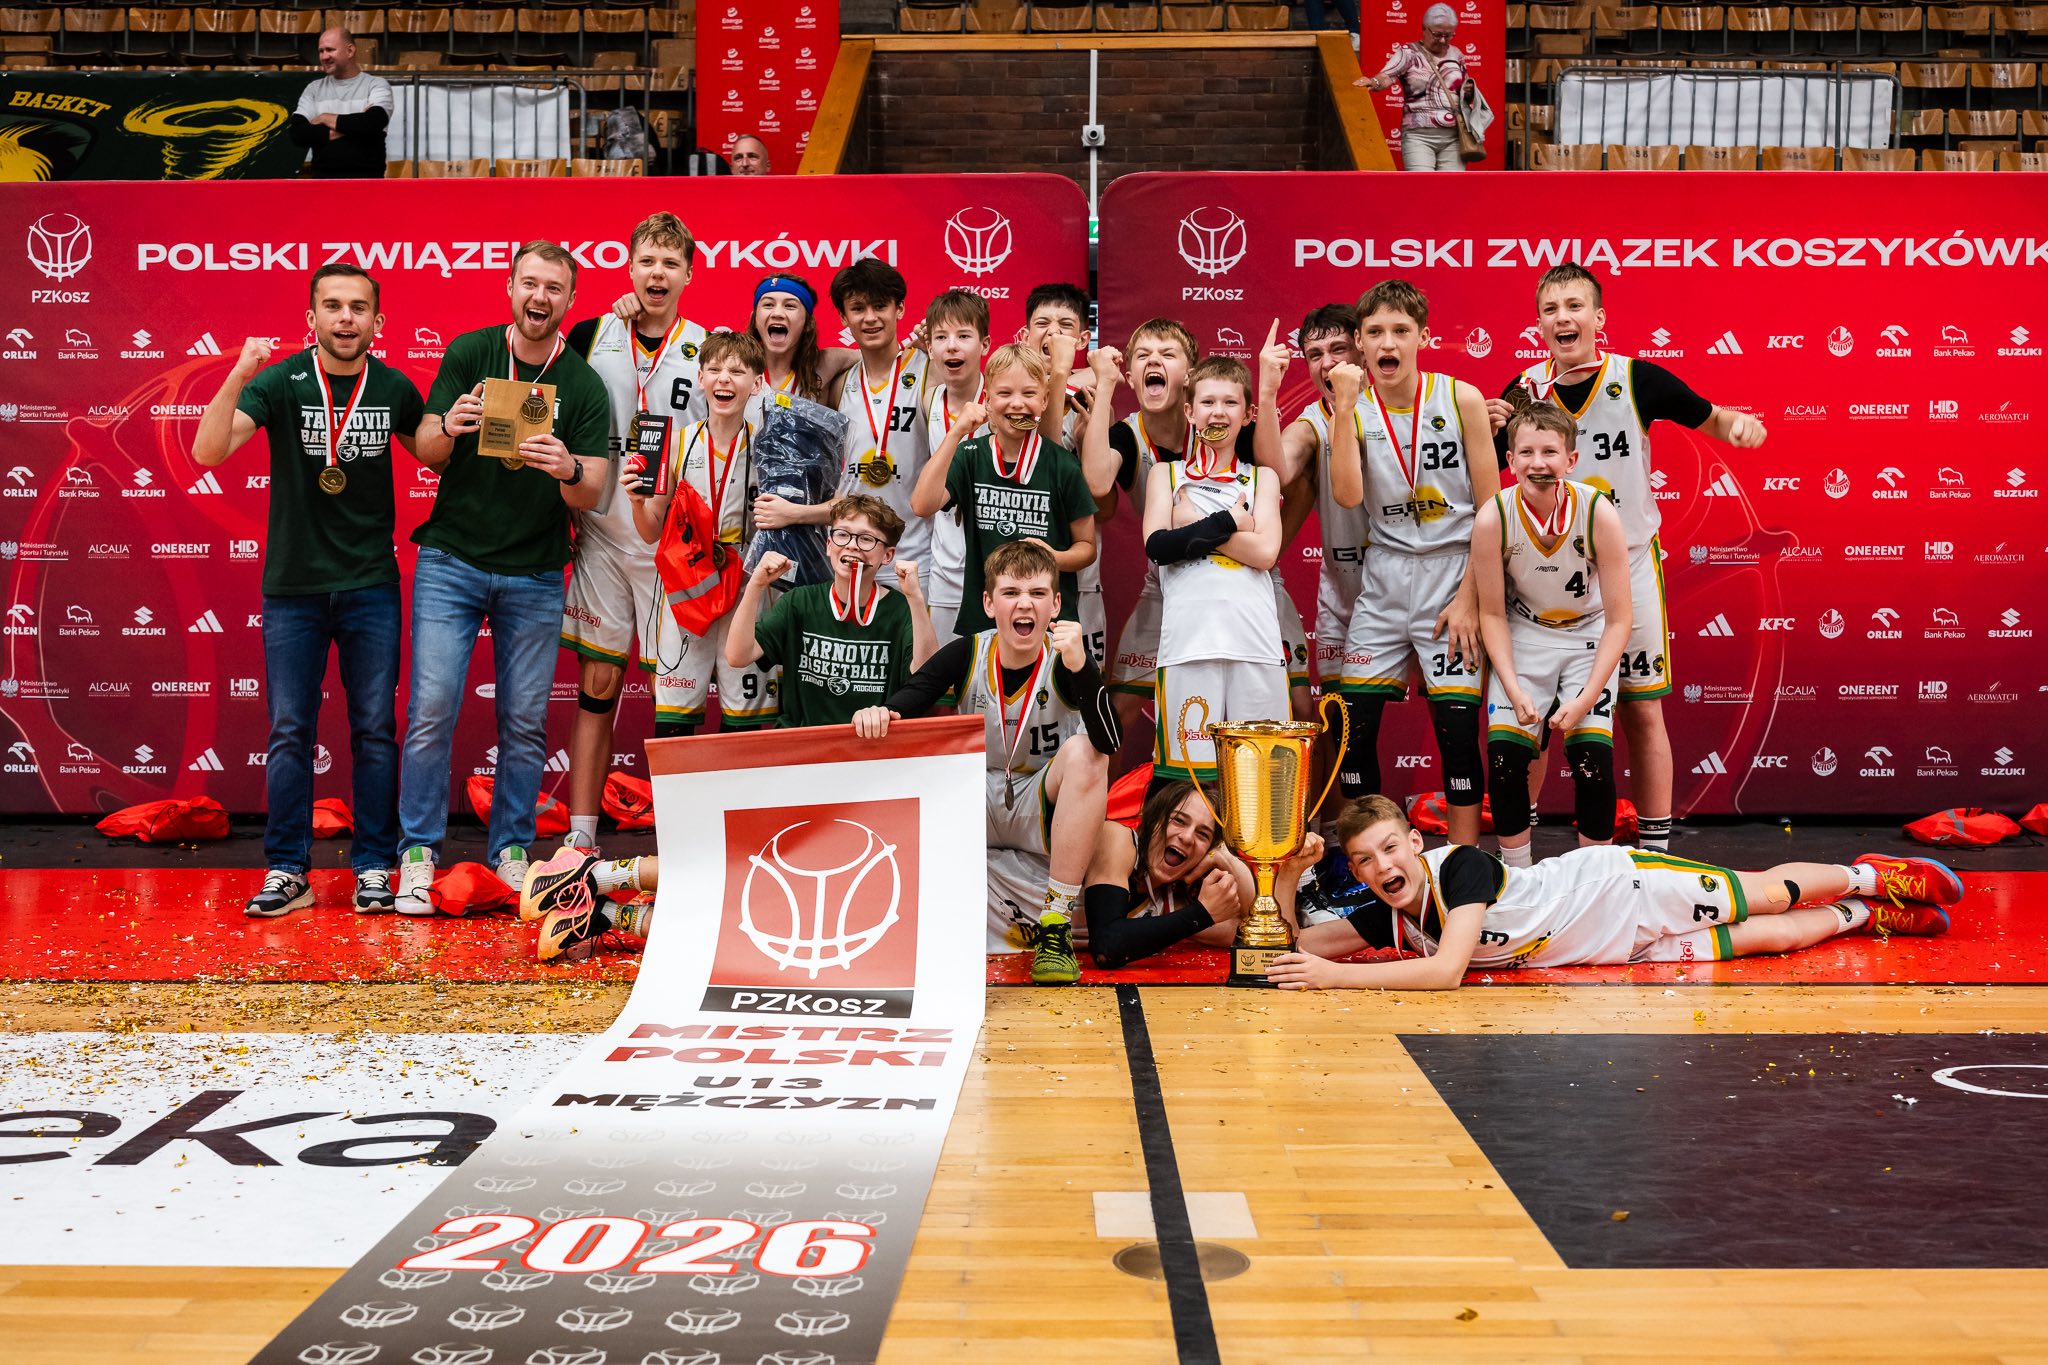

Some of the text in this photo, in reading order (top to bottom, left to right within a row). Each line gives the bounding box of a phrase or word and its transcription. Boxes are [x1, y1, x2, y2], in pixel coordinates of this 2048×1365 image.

[8, 91, 112, 118] BASKET
[138, 243, 308, 271] POLSKI
[567, 232, 899, 269] KOYKÓWKI
[1295, 240, 1472, 267] POLSKI
[1487, 239, 1719, 276] ZWIĄZEK
[32, 290, 89, 303] PZKosz
[1183, 287, 1243, 300] PZKosz
[1767, 336, 1804, 348] KFC
[3, 351, 36, 359] ORLEN
[1515, 348, 1551, 360] ORLEN
[1638, 350, 1683, 358] SUZUKI
[1876, 348, 1911, 357] ORLEN
[1998, 348, 2042, 356] SUZUKI
[673, 377, 692, 411] 6
[88, 406, 128, 416] ALCALIA
[150, 405, 208, 416] ONERENT
[1784, 405, 1826, 415] ALCALIA
[1849, 404, 1909, 414] ONERENT
[1930, 400, 1957, 413] HID
[301, 410, 391, 429] TAOVIA
[300, 430, 389, 445] BASETBALL
[640, 430, 662, 444] MVP
[1592, 431, 1630, 461] 34
[1421, 441, 1460, 471] 32
[1763, 478, 1800, 490] KFC
[3, 489, 37, 497] ORLEN
[122, 489, 165, 497] SUZUKI
[1872, 490, 1907, 499] ORLEN
[89, 544, 129, 553] ALCALIA
[151, 544, 210, 553] ONERENT
[230, 540, 258, 552] HID
[1780, 546, 1822, 557] ALCALIA
[1845, 546, 1905, 555] ONERENT
[1925, 542, 1953, 554] HID
[1758, 618, 1795, 630] KFC
[3, 625, 37, 636] ORLEN
[79, 626, 99, 635] Pekao
[1867, 631, 1902, 639] ORLEN
[802, 636, 889, 664] TARNOVIA
[798, 655, 888, 680] BASKETBALL
[1432, 652, 1463, 678] 32
[1619, 651, 1651, 678] 34
[21, 679, 57, 687] Ministerstwo
[89, 682, 130, 691] ALCALIA
[152, 682, 211, 691] ONERENT
[231, 679, 258, 691] HID
[742, 674, 758, 700] 9
[1919, 681, 1947, 693] HID
[44, 687, 69, 696] Turystyki
[1774, 685, 1816, 696] ALCALIA
[1839, 685, 1899, 694] ONERENT
[1728, 692, 1754, 700] Turystyki
[1968, 694, 2017, 702] AEROWATCH
[1029, 721, 1060, 756] 15
[4, 763, 39, 772] ORLEN
[1395, 756, 1432, 767] KFC
[1751, 754, 1788, 769] KFC
[79, 764, 100, 773] Pekao
[1346, 772, 1362, 785] NBA
[1456, 777, 1472, 791] NBA
[1692, 904, 1719, 922] 3
[1480, 930, 1510, 948] 3
[730, 992, 886, 1016] PZKosz
[628, 1023, 954, 1044] MISTRZ
[604, 1046, 947, 1067] POLSKI
[692, 1075, 824, 1090] U13
[552, 1090, 937, 1112] MĘŻCZYZN
[0, 1090, 498, 1167] eka
[395, 1213, 878, 1278] 2026
